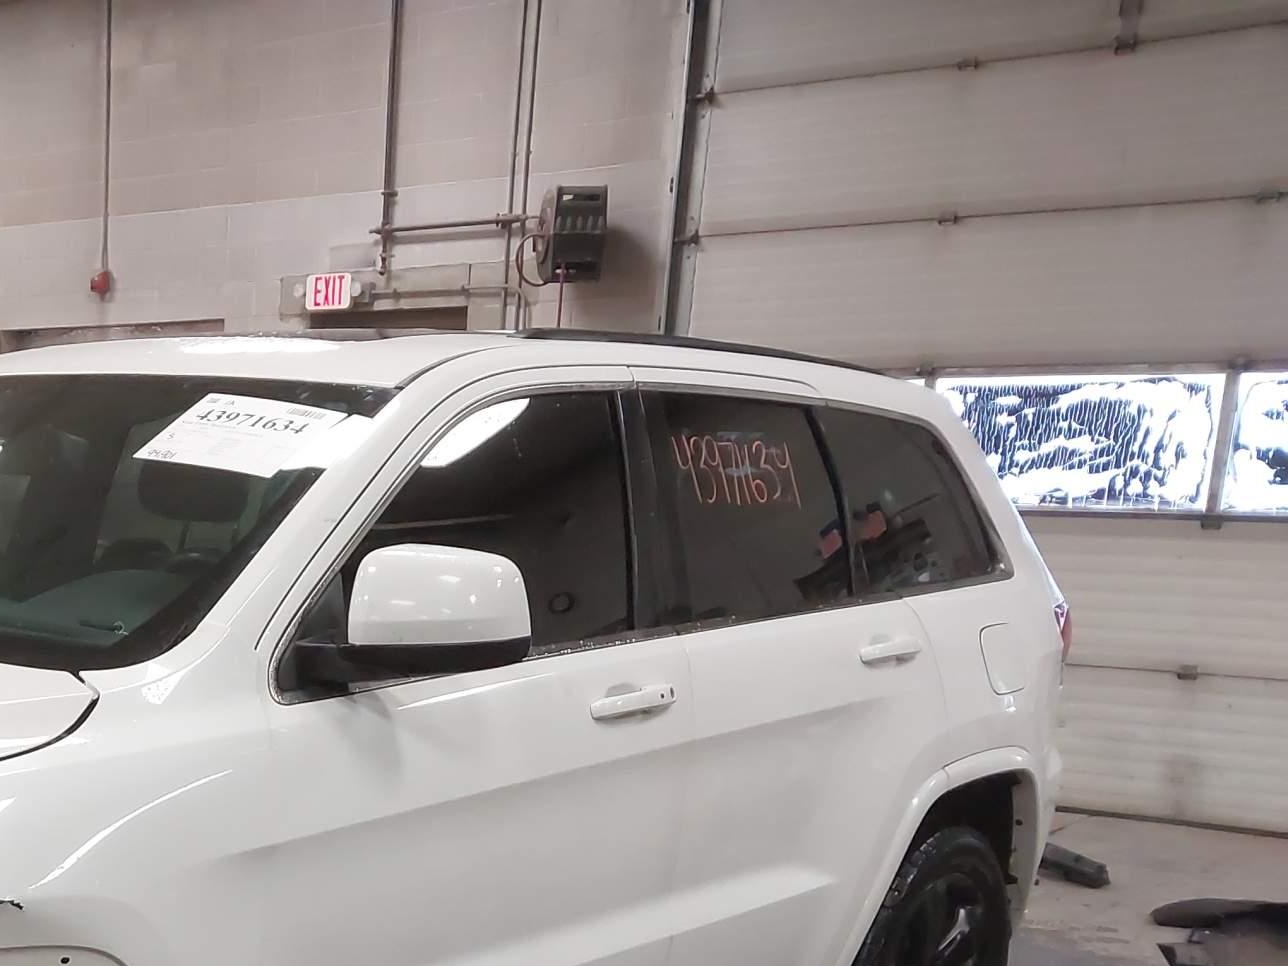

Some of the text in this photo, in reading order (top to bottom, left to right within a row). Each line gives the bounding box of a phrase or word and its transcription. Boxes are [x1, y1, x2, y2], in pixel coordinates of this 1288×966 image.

[313, 275, 345, 307] EXIT
[196, 408, 310, 434] 43971634
[672, 433, 802, 510] 43971634
